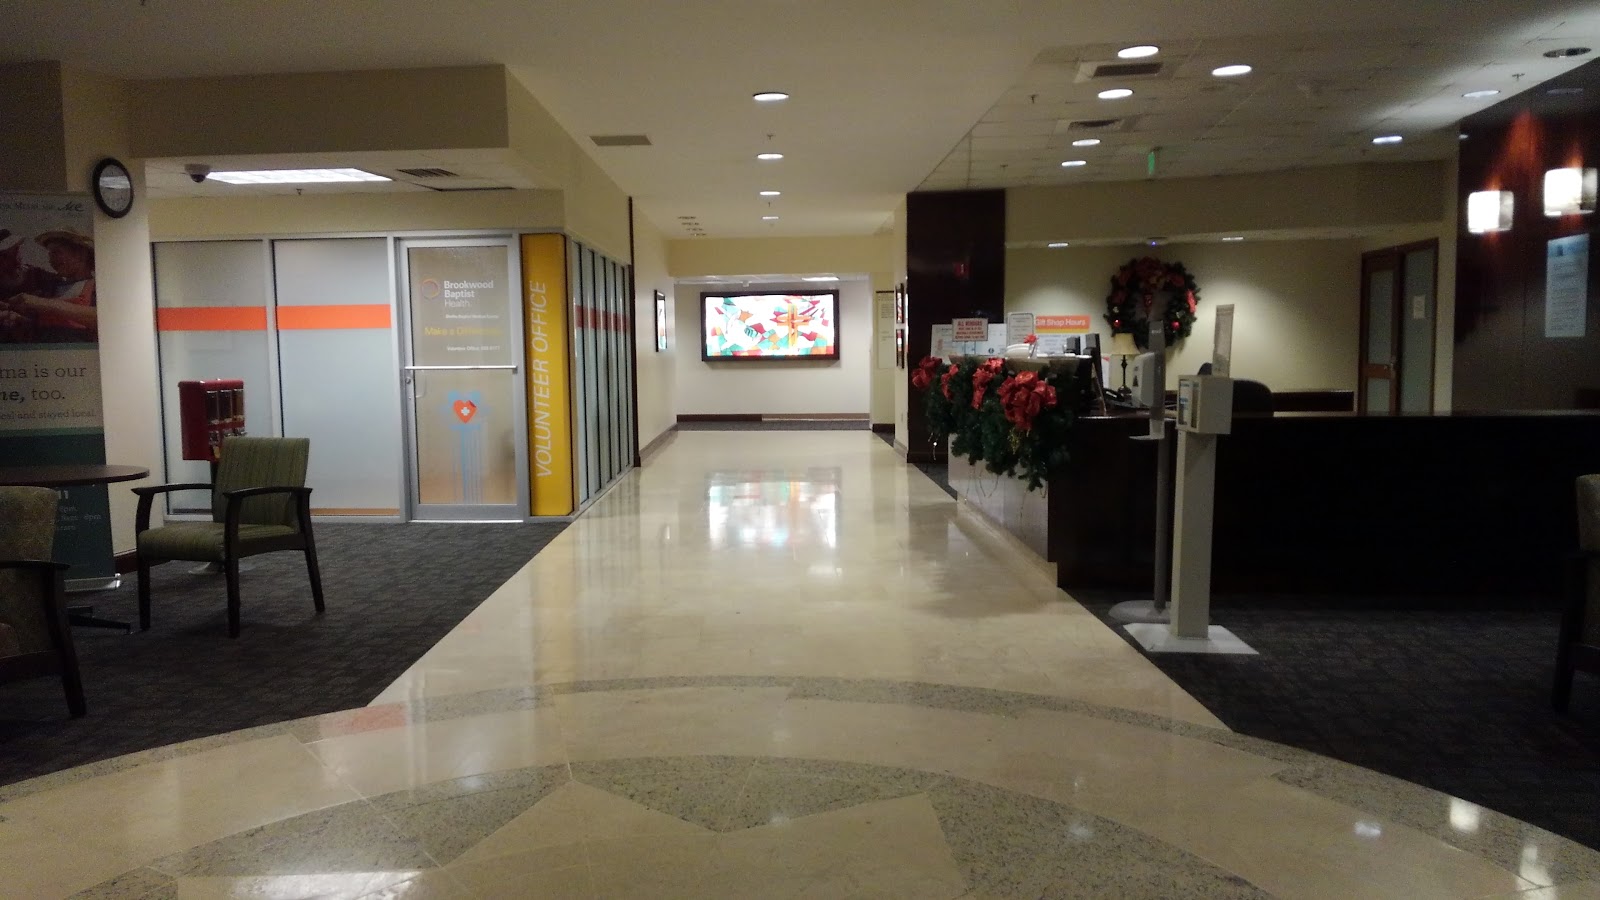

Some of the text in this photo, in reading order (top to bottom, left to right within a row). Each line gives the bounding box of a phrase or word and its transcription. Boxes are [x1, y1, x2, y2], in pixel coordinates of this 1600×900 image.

[443, 280, 494, 289] Brookwood
[444, 289, 475, 300] Baptist
[444, 299, 471, 307] Health
[1047, 318, 1065, 327] Shop
[1065, 318, 1086, 326] Hours
[34, 364, 49, 378] is
[54, 366, 87, 378] our
[529, 280, 552, 478] VOLUNTEER OFFICE
[31, 388, 65, 401] too.
